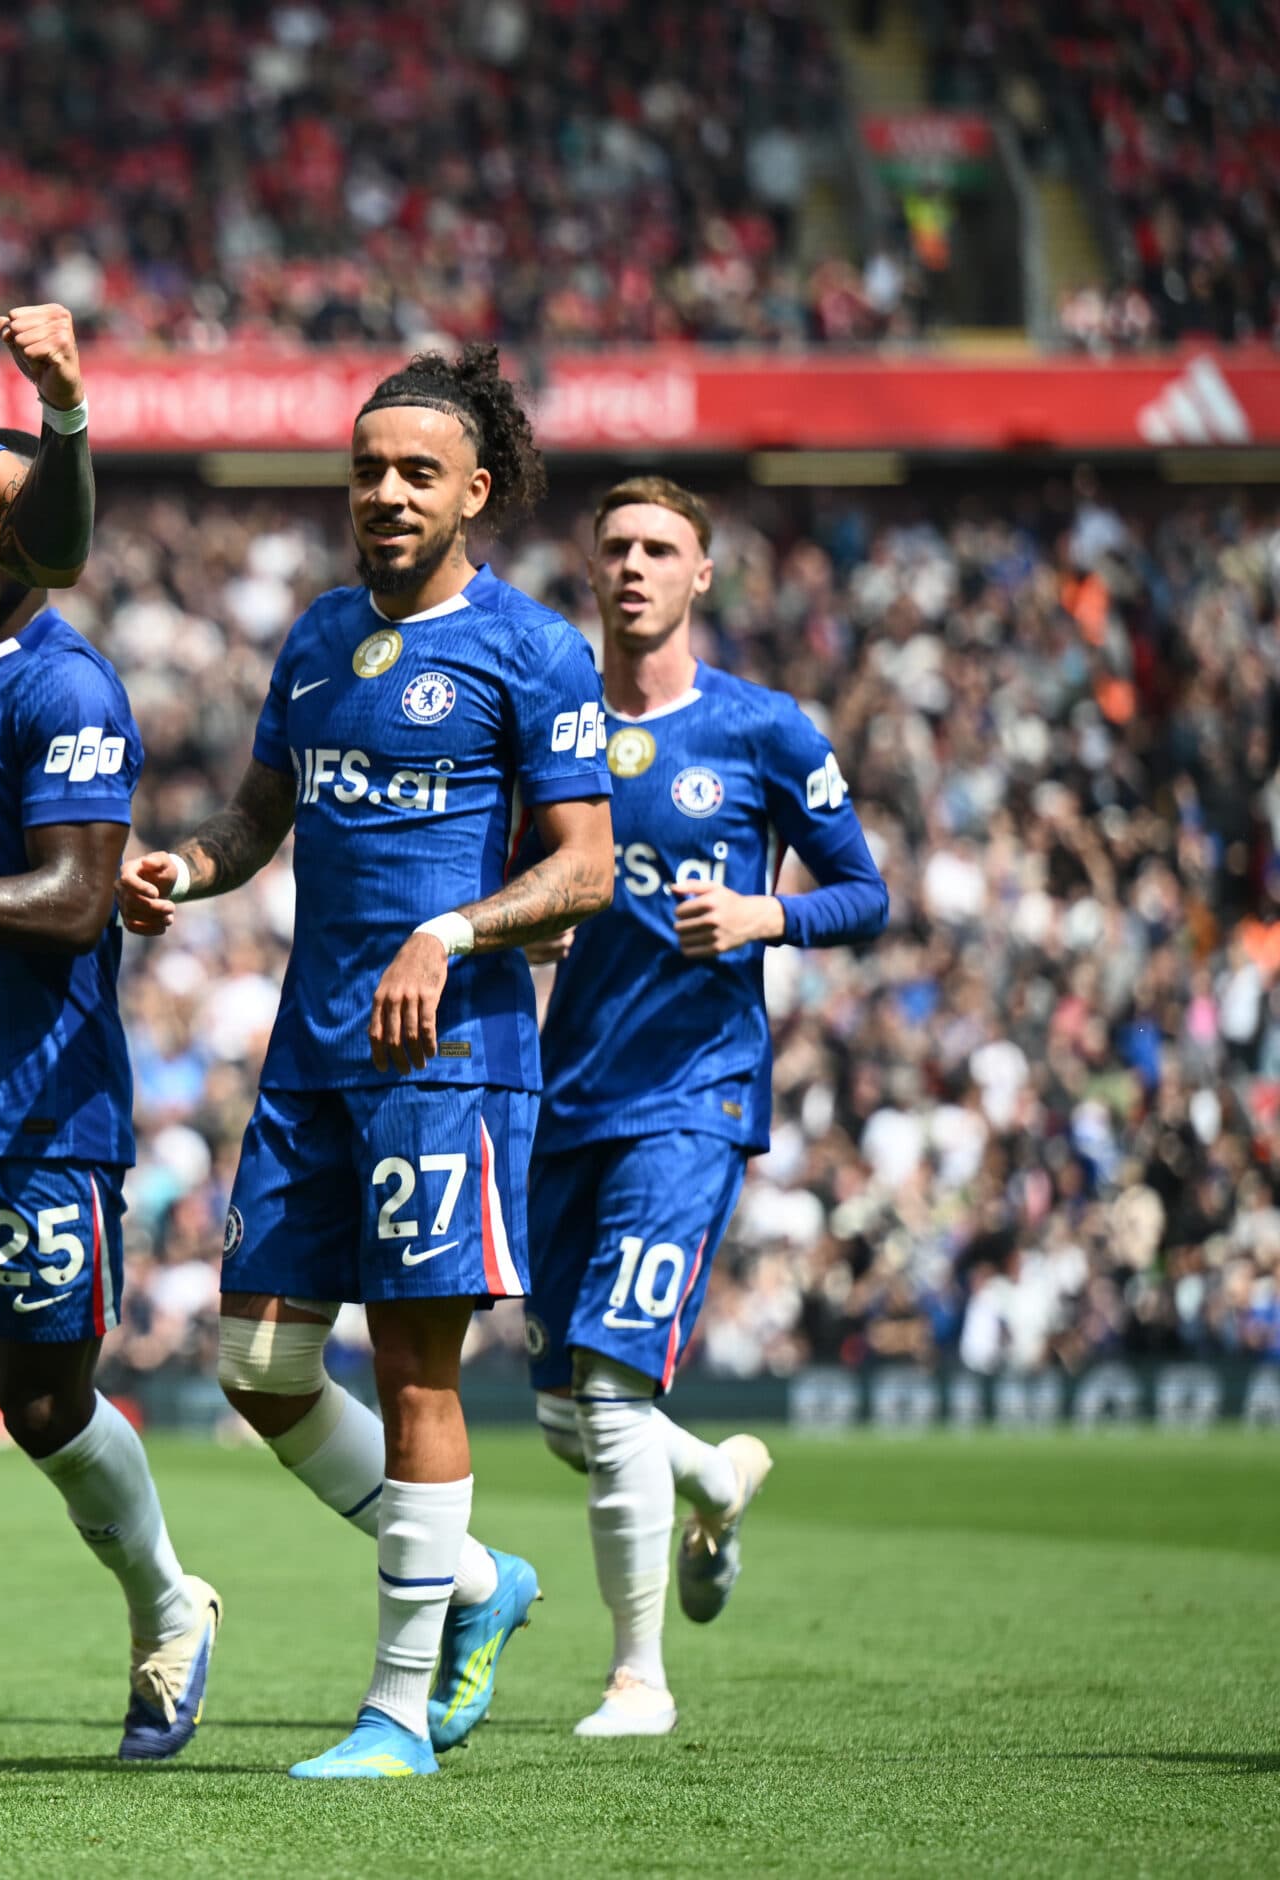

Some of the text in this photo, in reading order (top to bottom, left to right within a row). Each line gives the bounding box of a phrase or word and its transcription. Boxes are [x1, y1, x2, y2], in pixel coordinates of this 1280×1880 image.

[302, 749, 455, 813] IFS.ai
[372, 1153, 467, 1240] 27
[608, 1235, 685, 1318] 10
